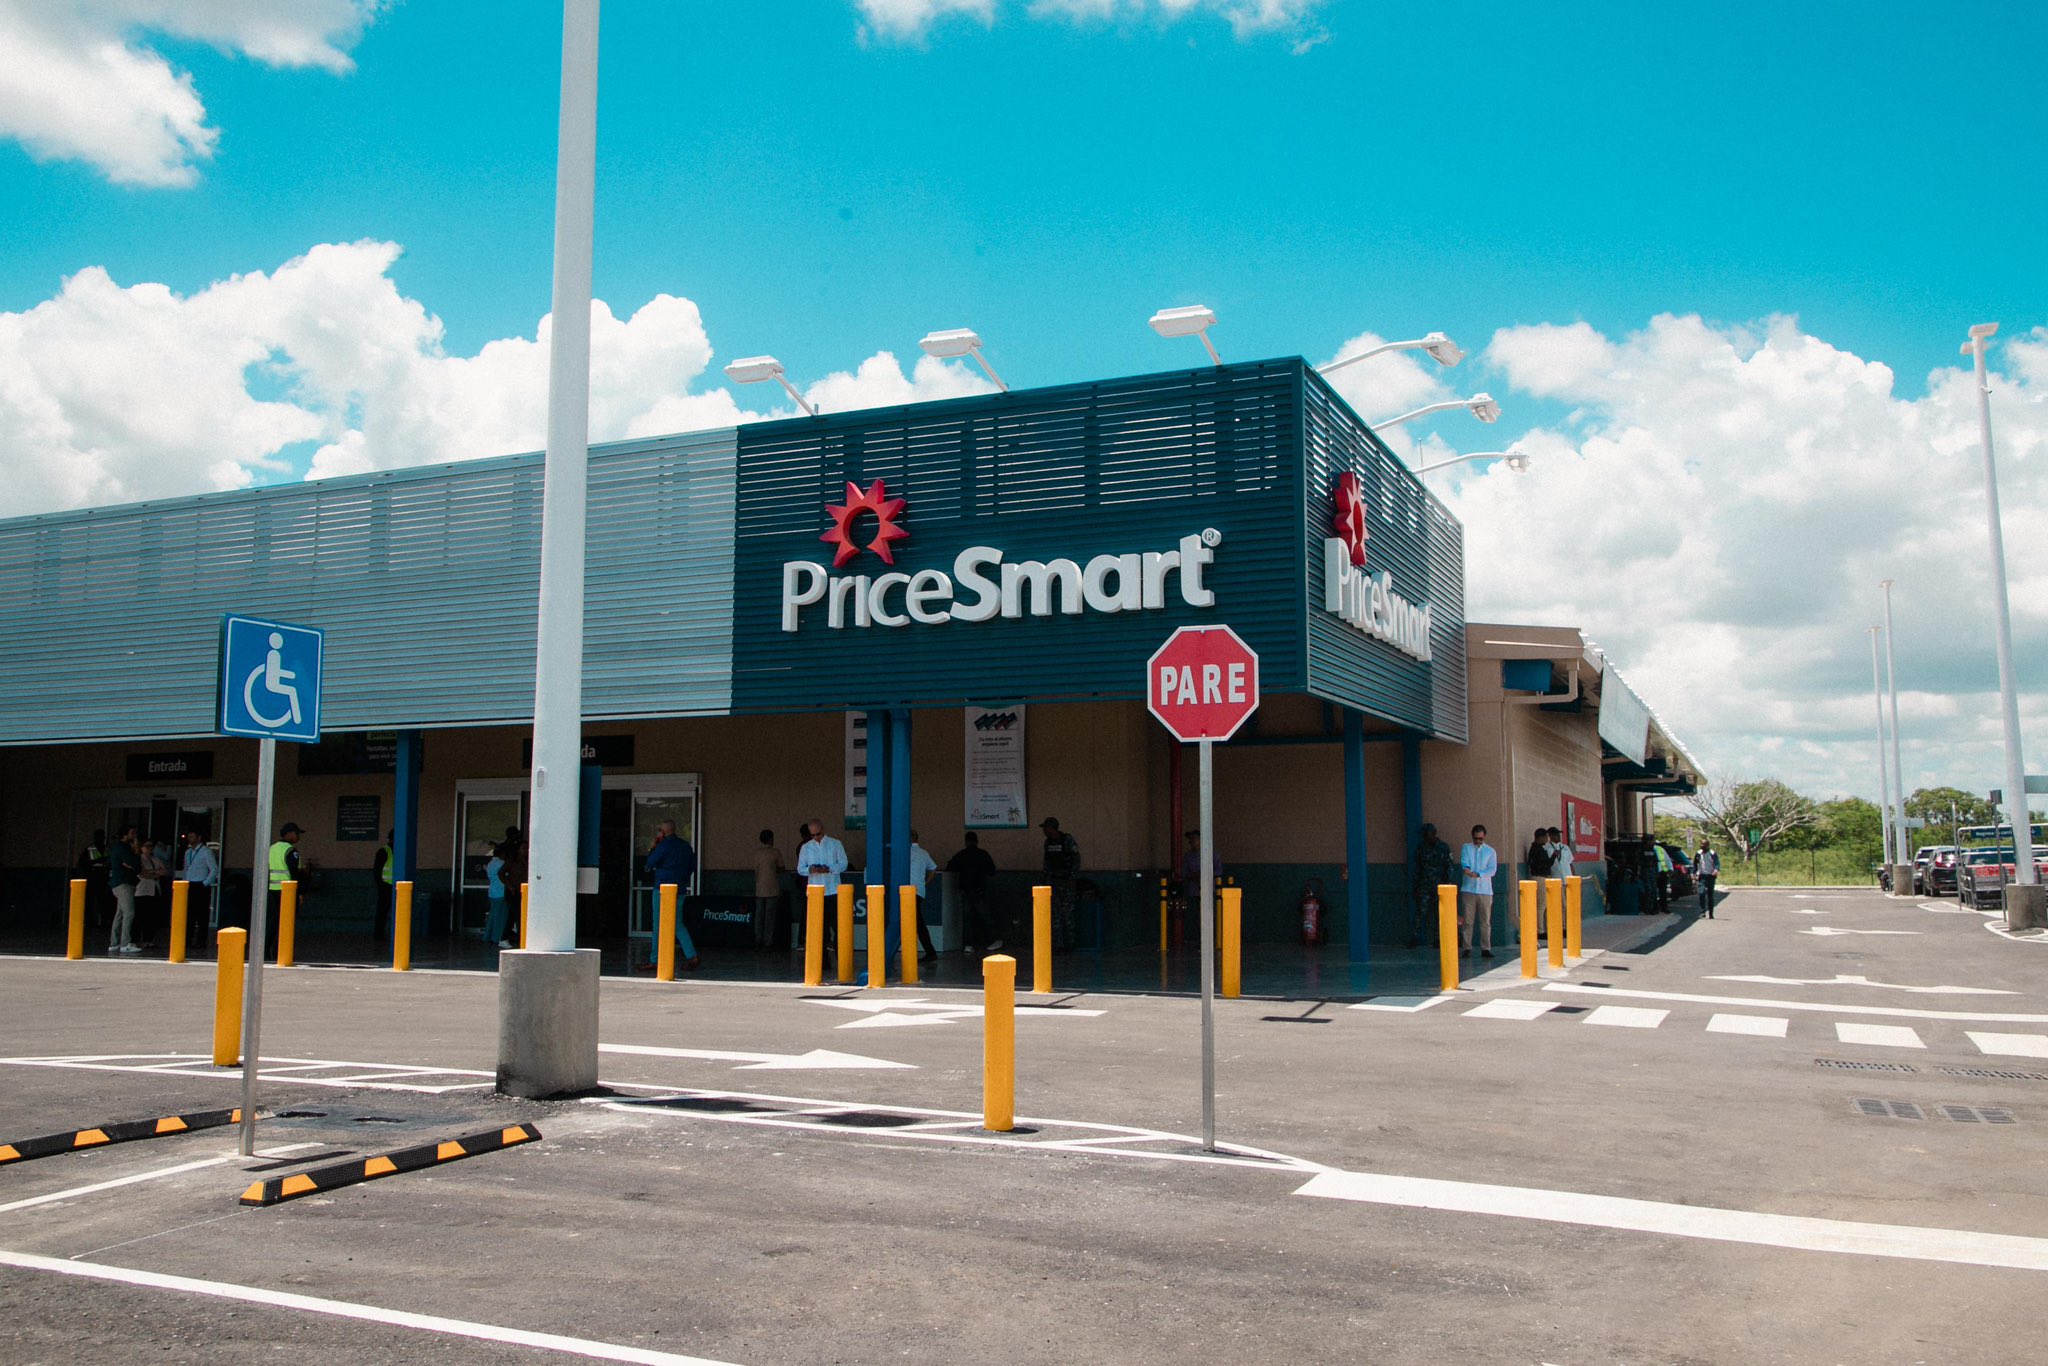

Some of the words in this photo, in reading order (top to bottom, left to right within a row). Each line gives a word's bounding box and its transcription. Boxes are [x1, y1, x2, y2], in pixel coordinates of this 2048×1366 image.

[1324, 537, 1432, 661] PriceSmart
[1160, 662, 1246, 706] PARE
[147, 759, 188, 774] Entrada
[703, 908, 752, 923] PriceSmart
